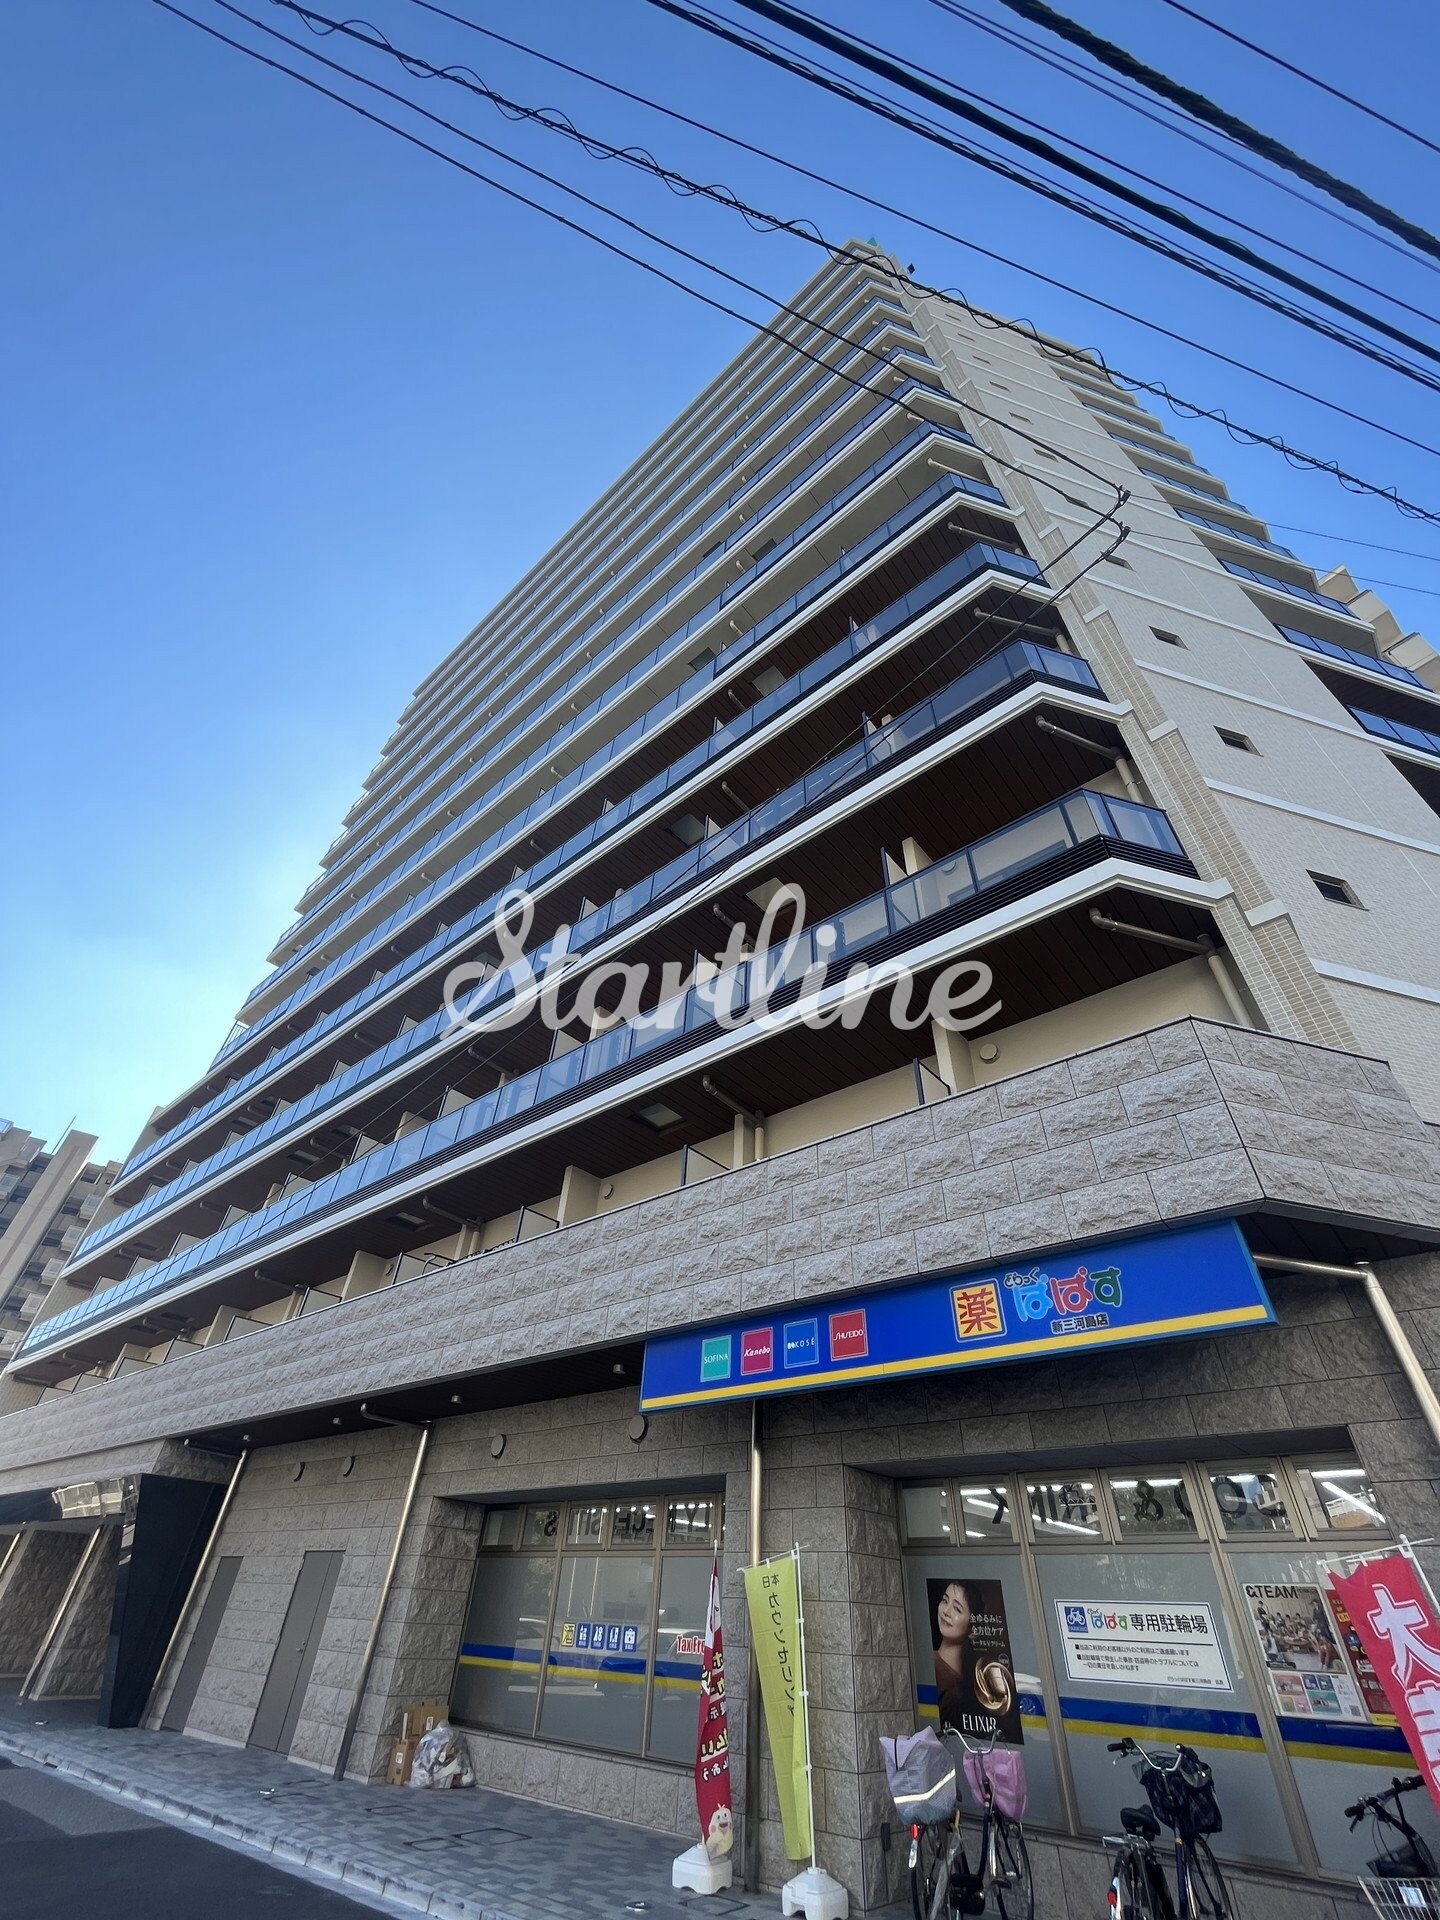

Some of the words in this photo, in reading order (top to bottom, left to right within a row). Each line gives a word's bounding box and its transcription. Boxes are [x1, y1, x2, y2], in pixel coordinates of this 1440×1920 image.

[957, 1287, 998, 1334] 薬
[1051, 1313, 1109, 1334] 新三河島店
[834, 1328, 864, 1341] SHISEIDO
[704, 1353, 729, 1364] SOFINA
[744, 1346, 771, 1357] Kanebo
[1246, 1585, 1299, 1599] &TEAM
[971, 1625, 1004, 1637] 全方位ケア
[1129, 1613, 1208, 1634] 専用駐輪場
[677, 1635, 692, 1653] Tax
[962, 1713, 997, 1733] ELIXIR
